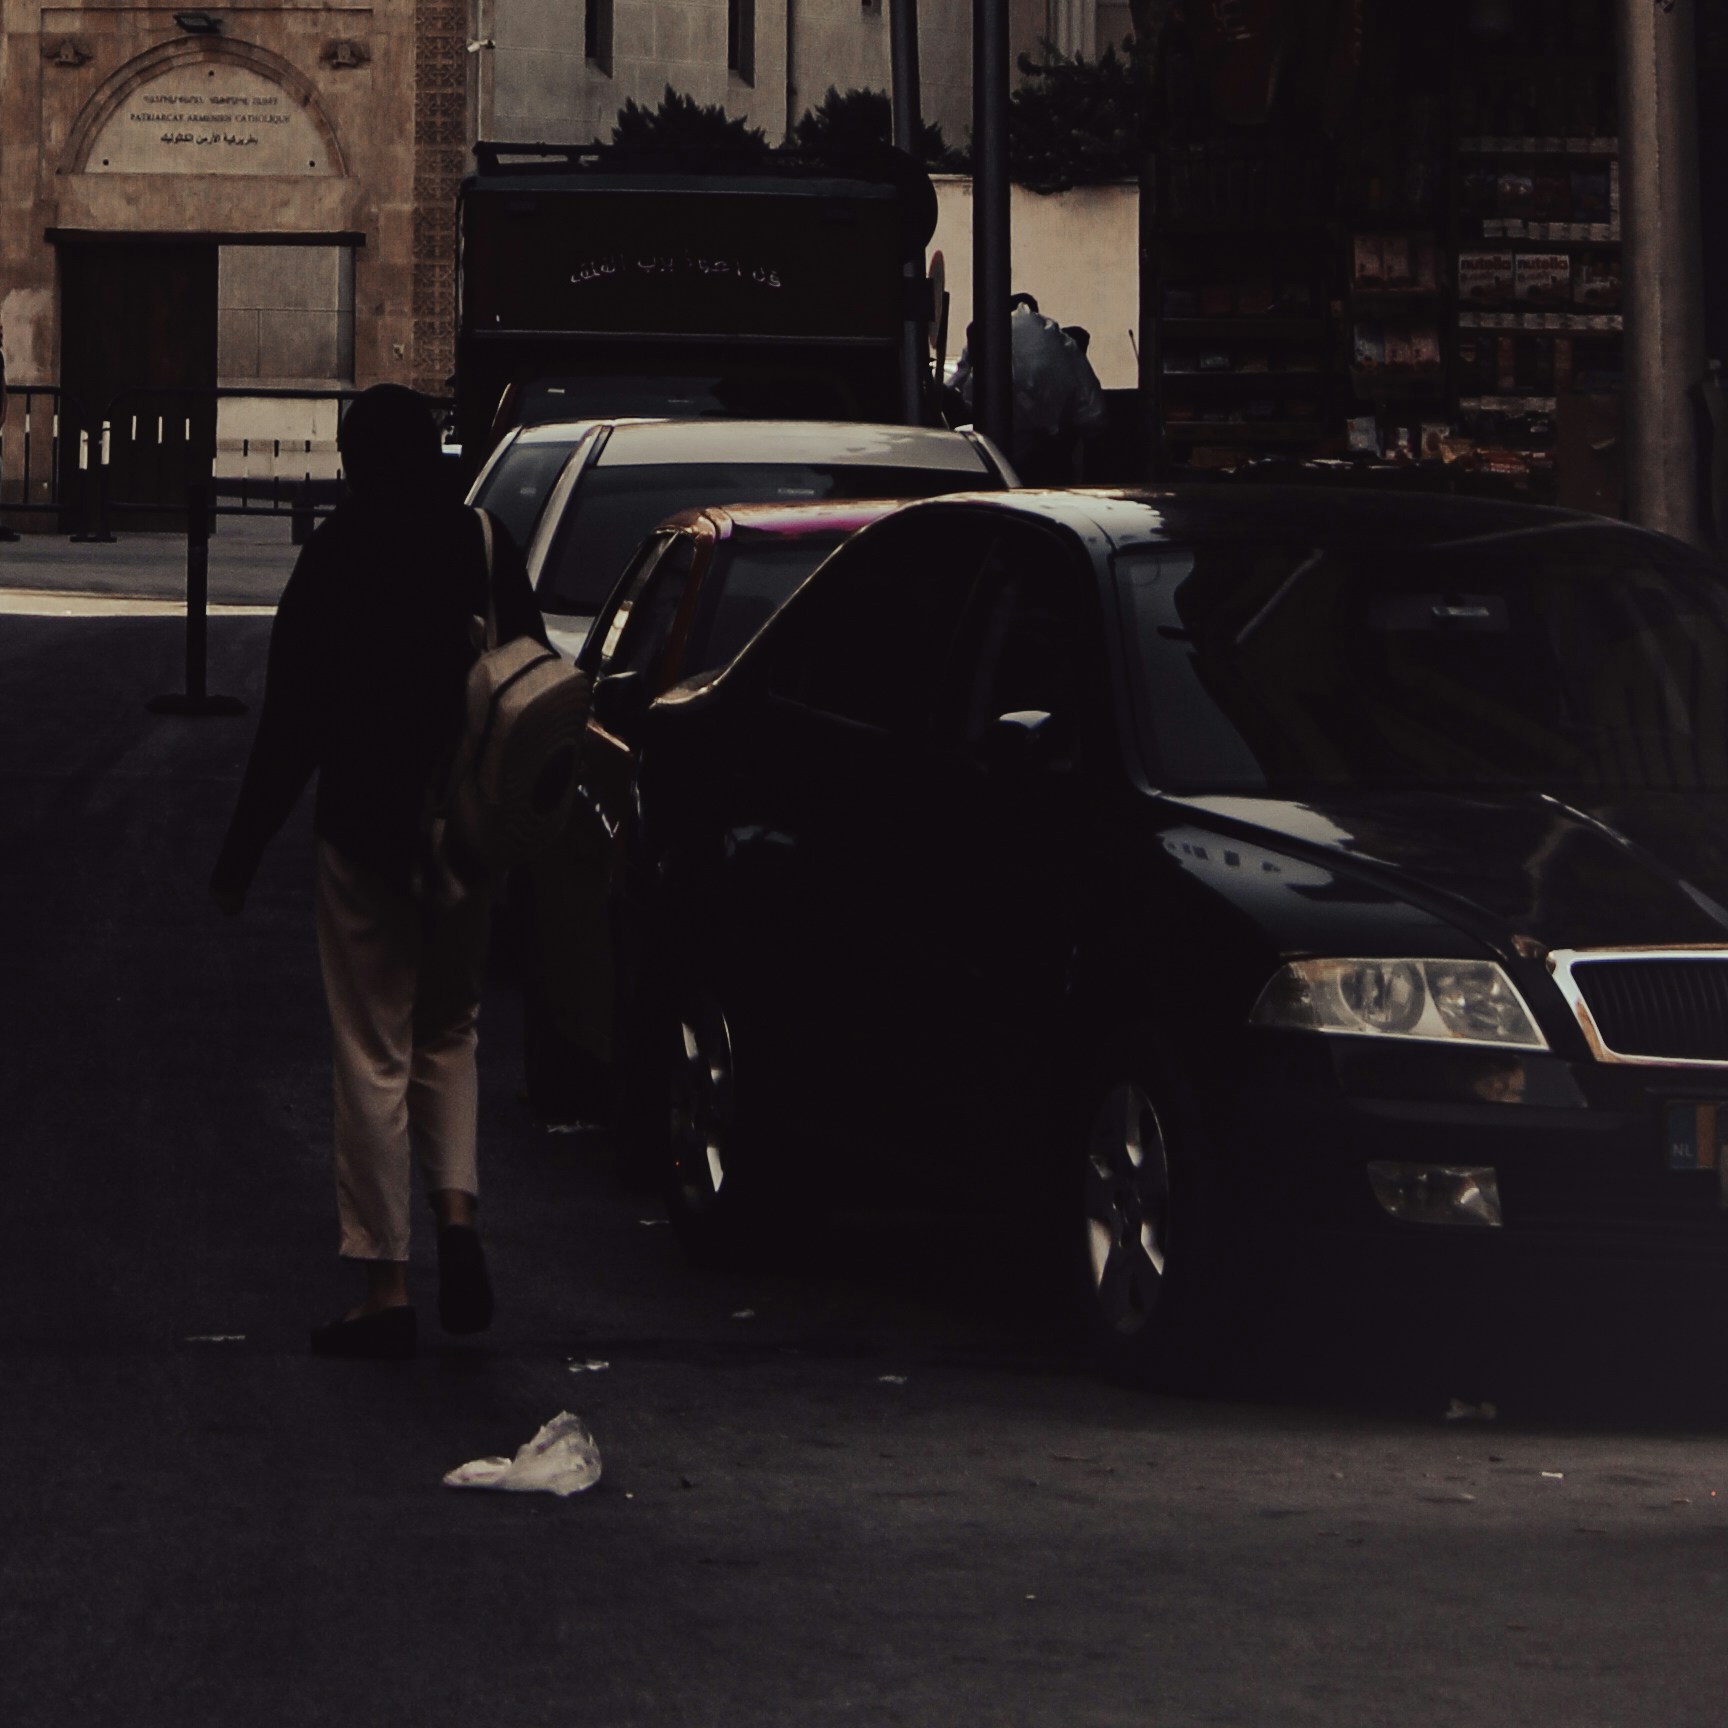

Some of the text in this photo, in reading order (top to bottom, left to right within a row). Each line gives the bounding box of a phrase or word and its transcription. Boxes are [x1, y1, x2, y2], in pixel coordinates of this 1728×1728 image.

[1460, 256, 1511, 271] nutella
[1517, 256, 1569, 271] nutella
[1671, 1142, 1694, 1158] NL
